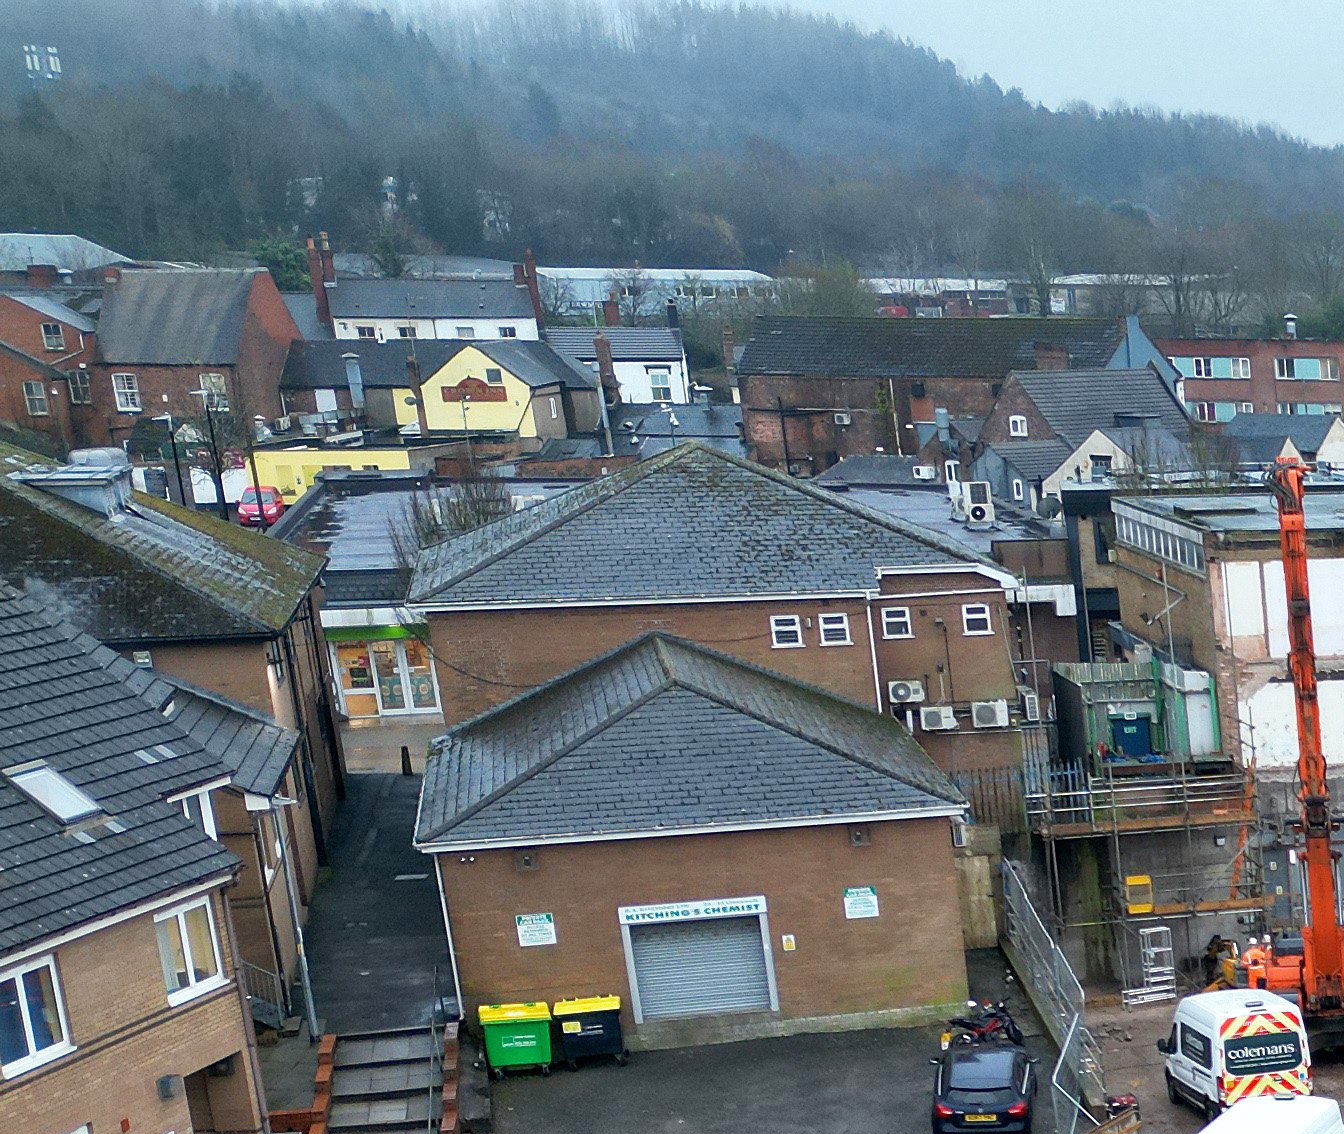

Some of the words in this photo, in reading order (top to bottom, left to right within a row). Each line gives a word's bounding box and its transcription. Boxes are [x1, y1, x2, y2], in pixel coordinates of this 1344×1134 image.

[625, 908, 701, 921] KITCHING'S
[703, 903, 760, 915] CHEMIST
[1228, 1043, 1295, 1060] colemans
